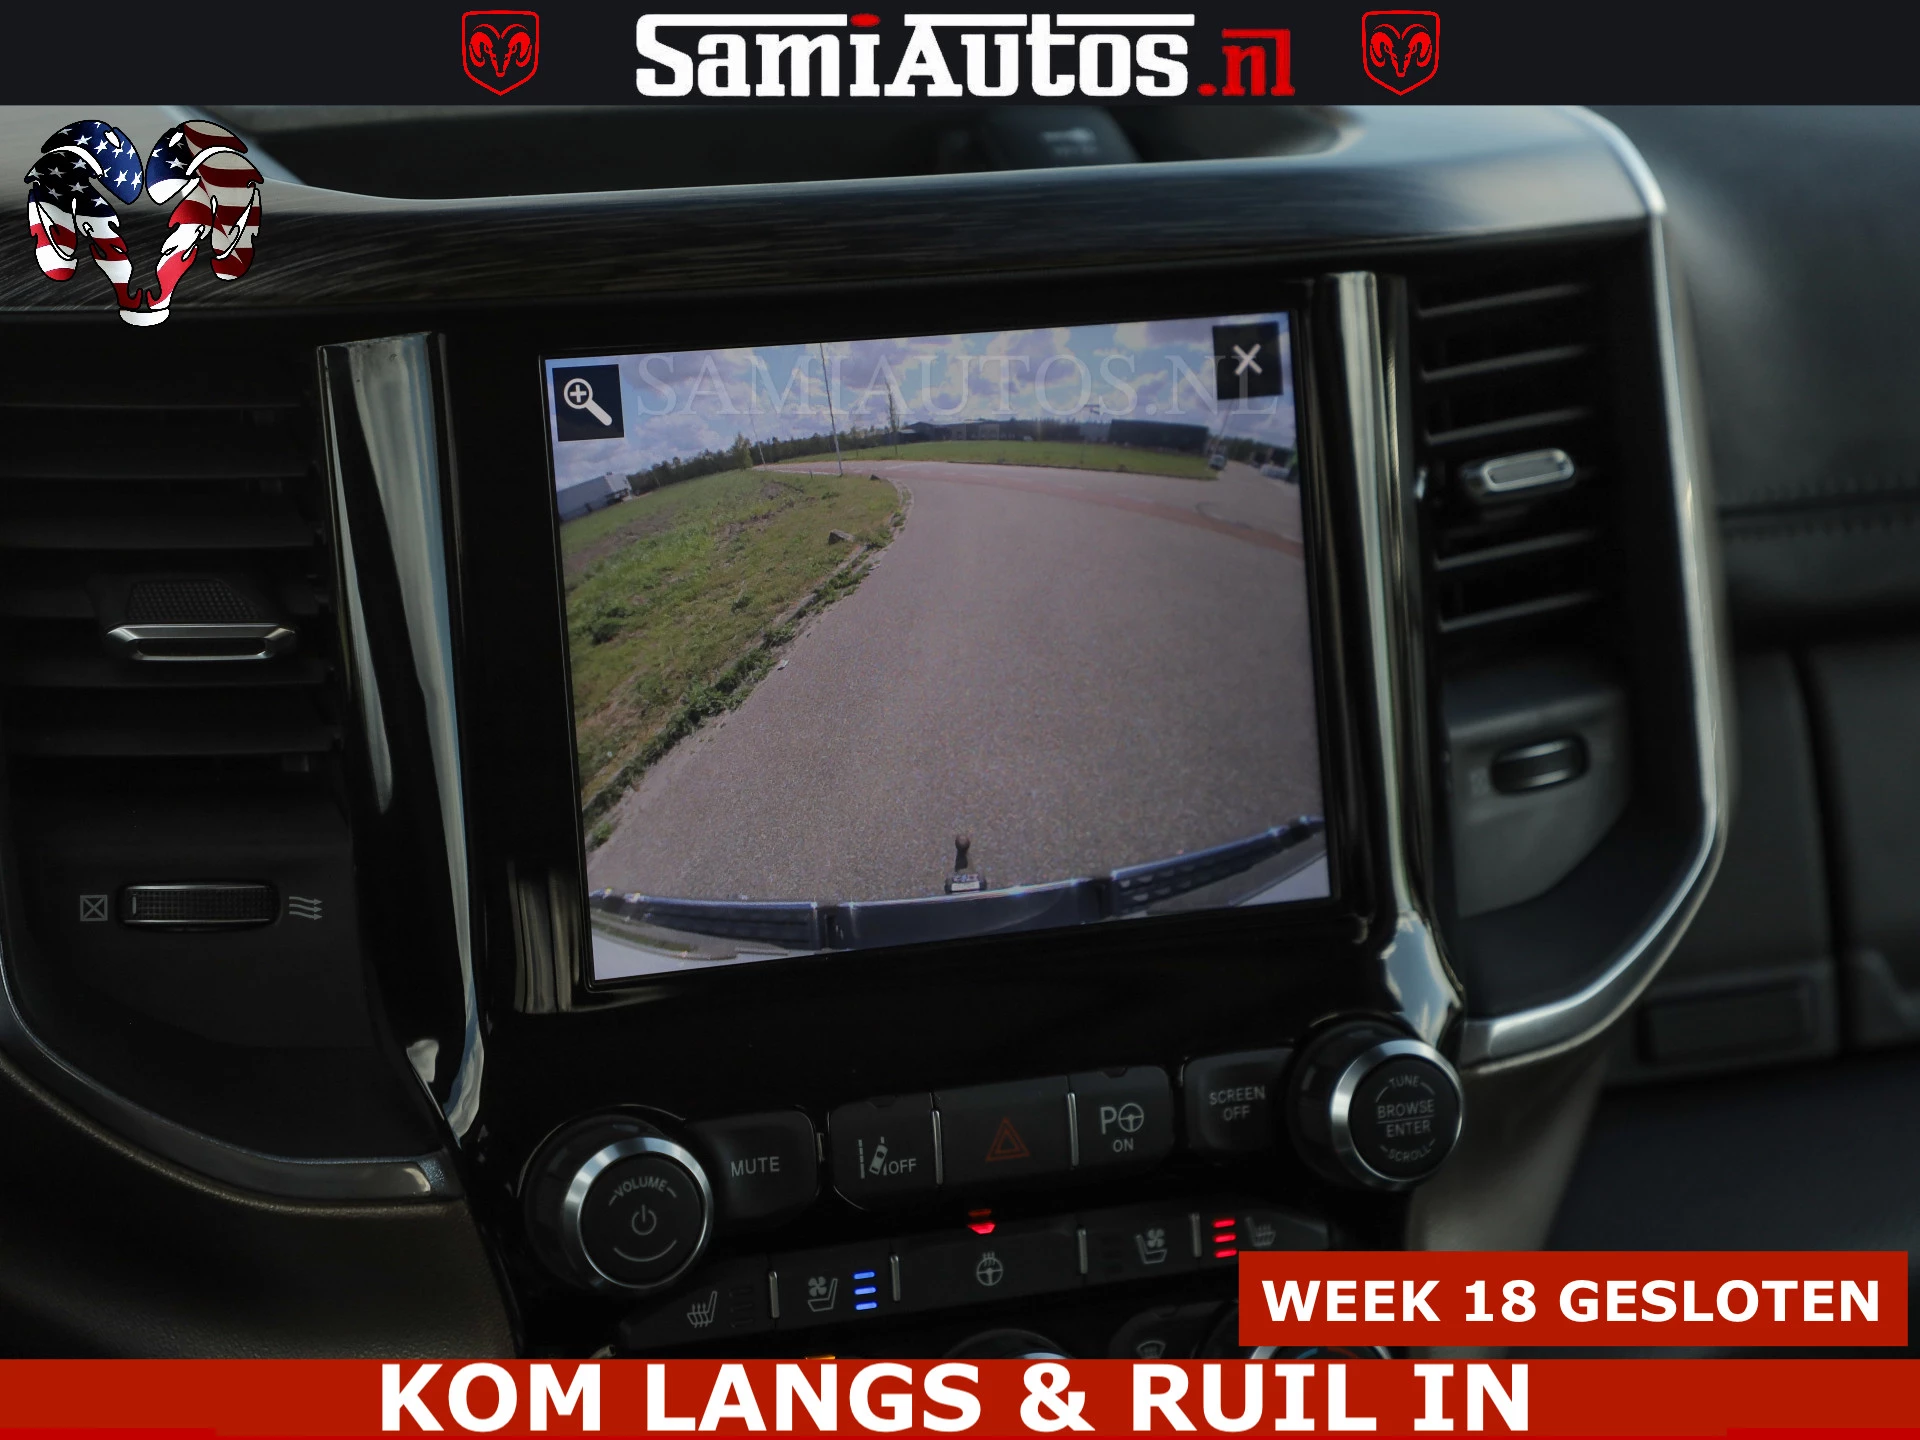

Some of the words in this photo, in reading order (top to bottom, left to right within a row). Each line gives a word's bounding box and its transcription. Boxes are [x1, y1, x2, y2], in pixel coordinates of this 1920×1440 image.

[1388, 1074, 1421, 1090] TUNE
[1209, 1086, 1266, 1106] SCREEN
[1222, 1105, 1250, 1121] OFF
[1377, 1100, 1435, 1119] BROWSE
[1386, 1119, 1431, 1137] ENTER
[1112, 1138, 1134, 1153] ON
[1388, 1144, 1433, 1162] SCROLL
[731, 1156, 780, 1178] MUTE
[888, 1157, 917, 1175] OFF
[614, 1177, 667, 1198] VOLUME
